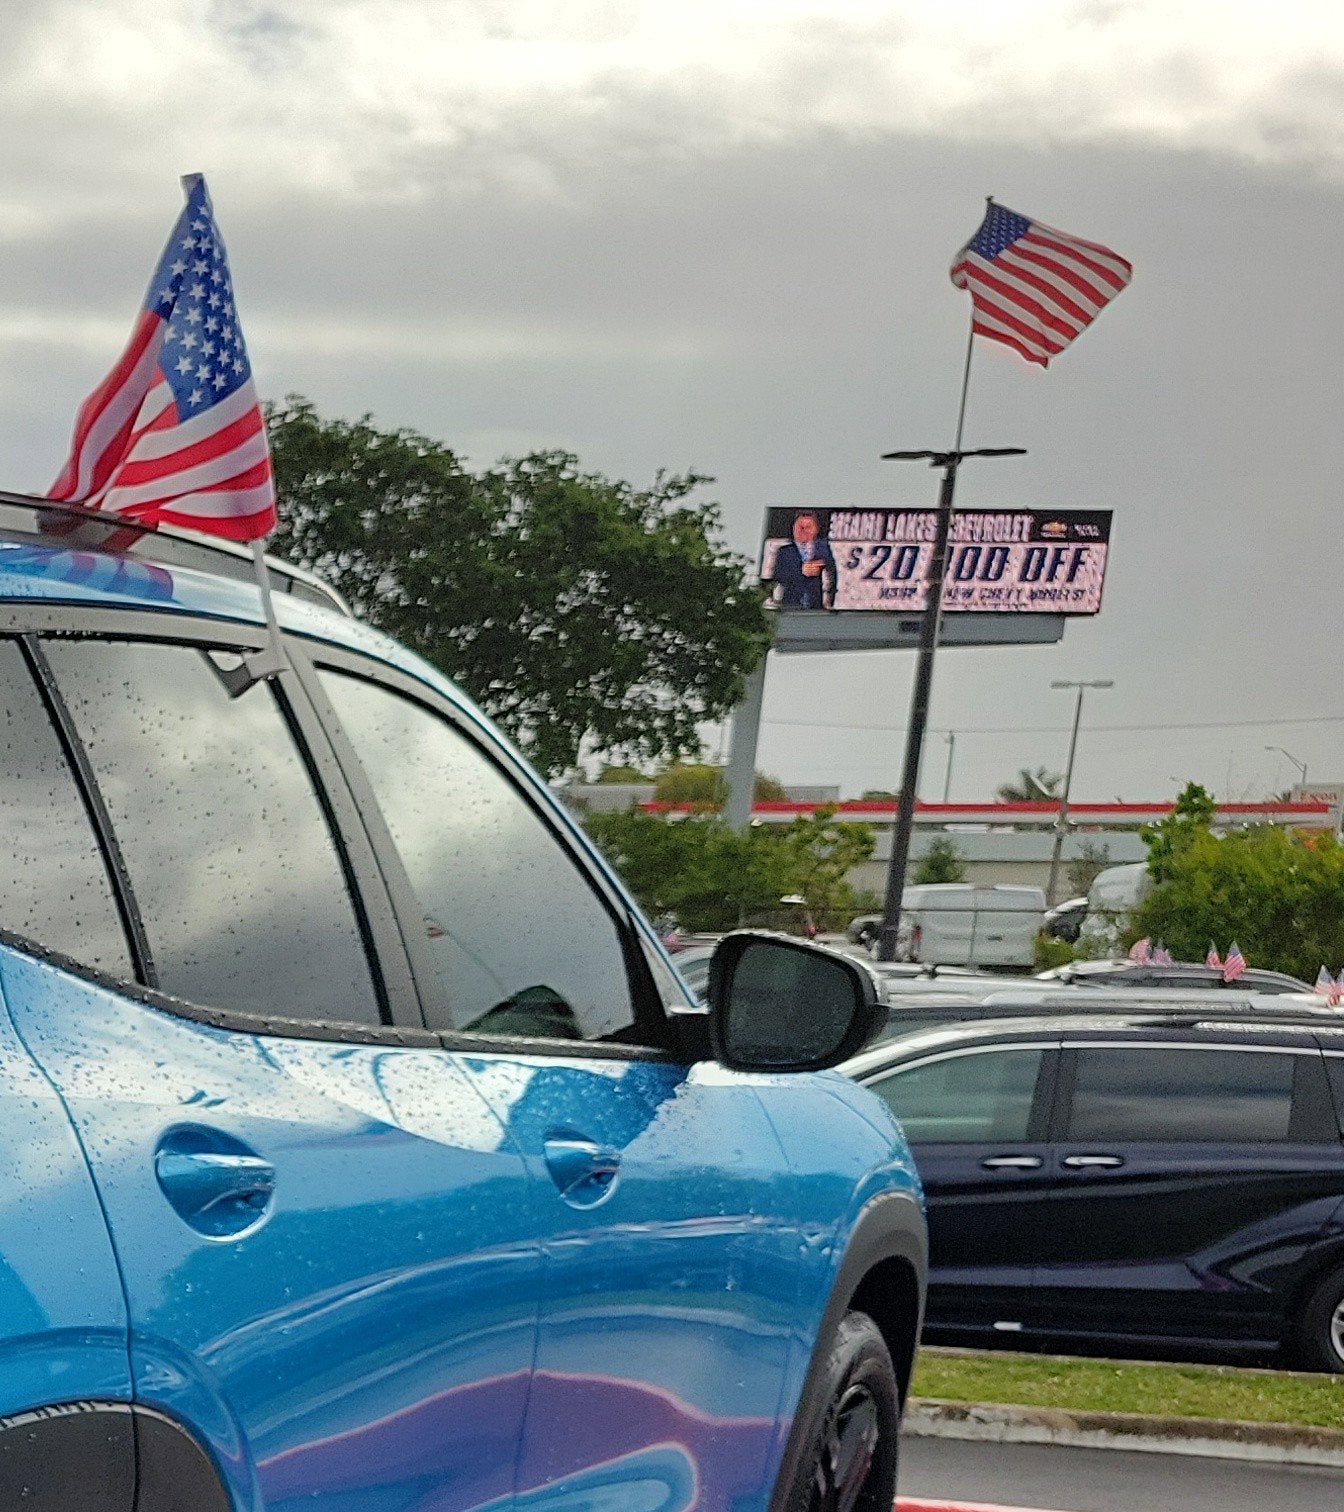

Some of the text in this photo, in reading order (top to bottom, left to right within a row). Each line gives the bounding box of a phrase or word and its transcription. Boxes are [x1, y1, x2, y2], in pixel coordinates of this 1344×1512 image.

[828, 512, 884, 540] MIAMI
[886, 512, 937, 541] LAKES
[1018, 547, 1090, 582] OFF
